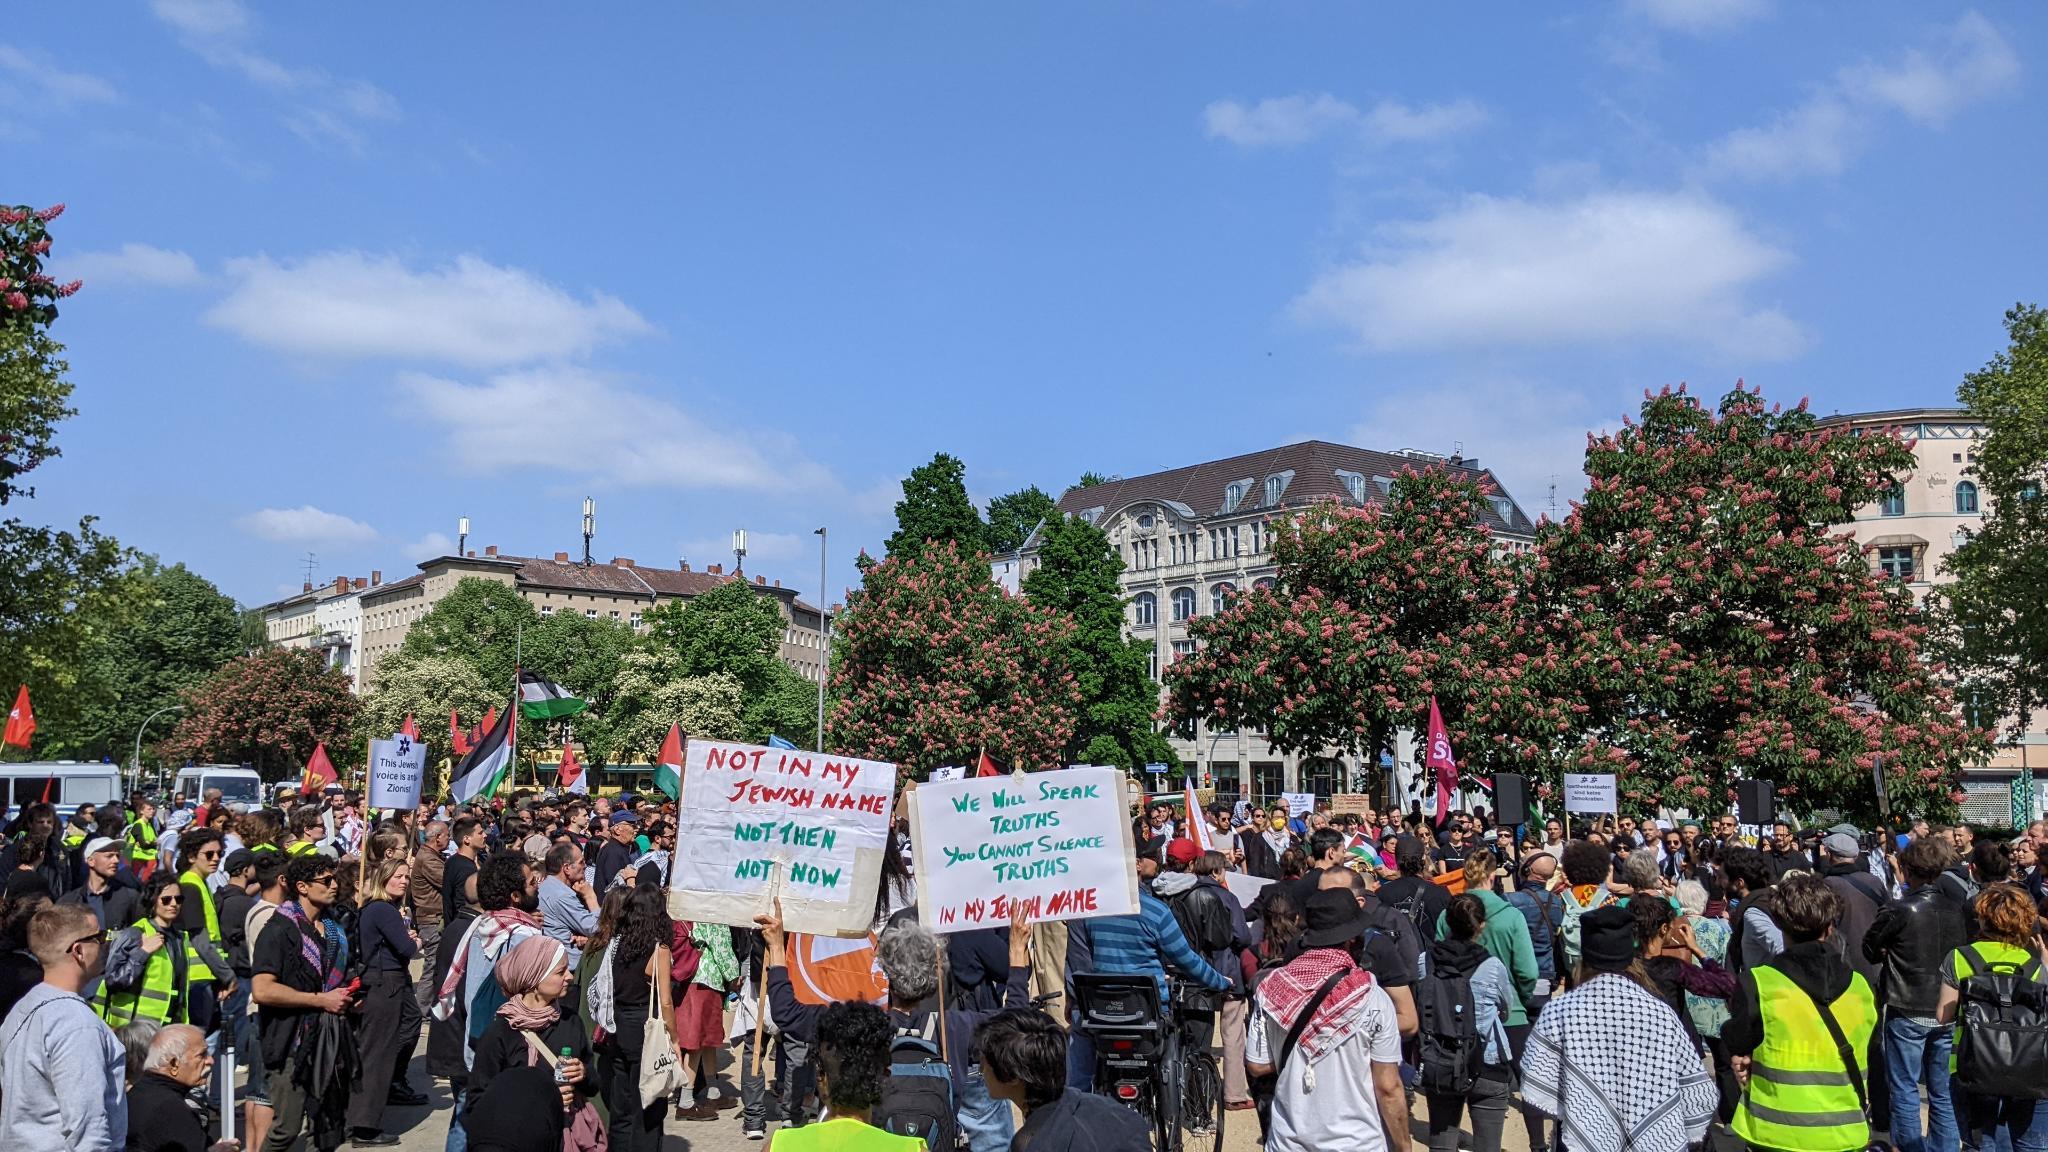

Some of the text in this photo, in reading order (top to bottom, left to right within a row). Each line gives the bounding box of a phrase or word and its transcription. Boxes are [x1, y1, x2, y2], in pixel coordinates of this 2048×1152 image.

[376, 771, 398, 780] voice
[400, 772, 406, 781] is
[380, 758, 419, 769] This Jewish
[707, 748, 860, 789] NOT IN MY
[387, 784, 411, 793] Zionist
[726, 778, 887, 814] JEWISH NAME
[952, 781, 1100, 813] WE WILL SPEAK
[734, 821, 837, 852] NOT THEN
[990, 811, 1061, 835] TRUTHS
[978, 841, 1034, 861] CANNOT
[1037, 835, 1105, 853] SILENCE
[734, 859, 841, 889] NOT NOW
[993, 857, 1070, 883] TRUTHS
[939, 905, 956, 925] IN
[964, 897, 985, 923] MY
[1046, 887, 1098, 916] NAME
